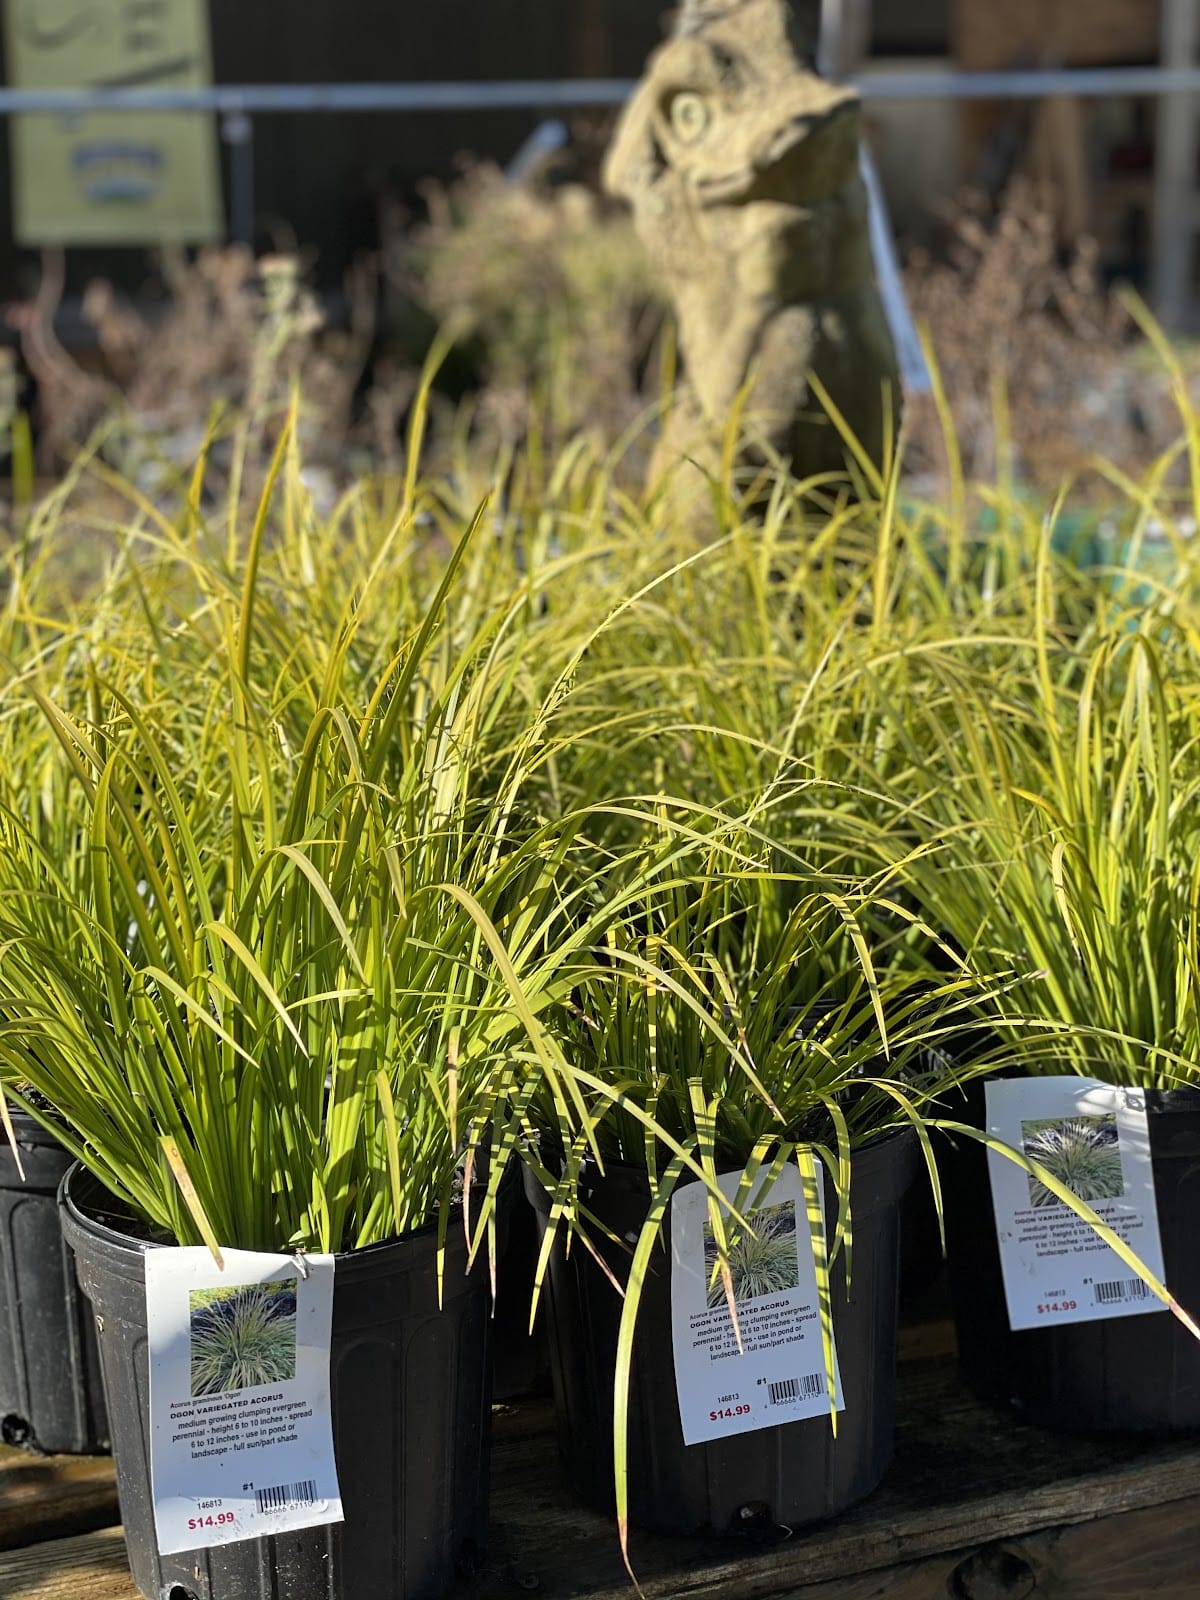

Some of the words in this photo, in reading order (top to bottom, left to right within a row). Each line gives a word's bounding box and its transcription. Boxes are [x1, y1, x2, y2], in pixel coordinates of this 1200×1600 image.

[1038, 1212, 1079, 1222] VARIEGATE
[690, 1319, 712, 1329] OGON
[760, 1299, 790, 1312] ACORUS
[1036, 1300, 1078, 1314] $14.99
[692, 1334, 722, 1348] perennial
[770, 1319, 791, 1329] inches
[795, 1312, 817, 1323] spread
[697, 1326, 723, 1337] medium
[750, 1312, 779, 1325] clumping
[780, 1304, 811, 1317] evergreen
[723, 1341, 731, 1349] 12
[757, 1333, 769, 1341] use
[777, 1326, 794, 1337] pond
[747, 1343, 758, 1352] full
[759, 1338, 785, 1350] sun/part
[786, 1333, 805, 1343] shade
[756, 1377, 767, 1386] #1
[170, 1410, 195, 1419] OGON
[196, 1400, 249, 1415] VARIEGATED
[251, 1393, 284, 1405] ACORUS
[717, 1393, 740, 1404] 146813
[178, 1419, 207, 1430] medium
[208, 1413, 237, 1426] growing
[238, 1407, 271, 1419] clumping
[272, 1401, 307, 1413] evergreen
[709, 1404, 751, 1421] $14.99
[172, 1428, 206, 1443] perennial
[211, 1423, 234, 1434] height
[235, 1422, 240, 1430] 6
[241, 1421, 249, 1429] to
[250, 1419, 259, 1428] 10
[260, 1414, 283, 1425] inches
[289, 1408, 313, 1420] spread
[191, 1440, 196, 1448] 6
[206, 1437, 215, 1446] 12
[216, 1434, 240, 1444] inches
[245, 1430, 259, 1438] use
[260, 1427, 267, 1435] in
[268, 1423, 287, 1436] pond
[287, 1423, 295, 1431] or
[191, 1448, 228, 1459] landscape
[233, 1441, 245, 1451] full
[246, 1436, 275, 1449] sun/part
[277, 1432, 298, 1443] shade
[242, 1482, 254, 1491] #1
[197, 1498, 222, 1510] 146813
[187, 1511, 235, 1530] $14.99
